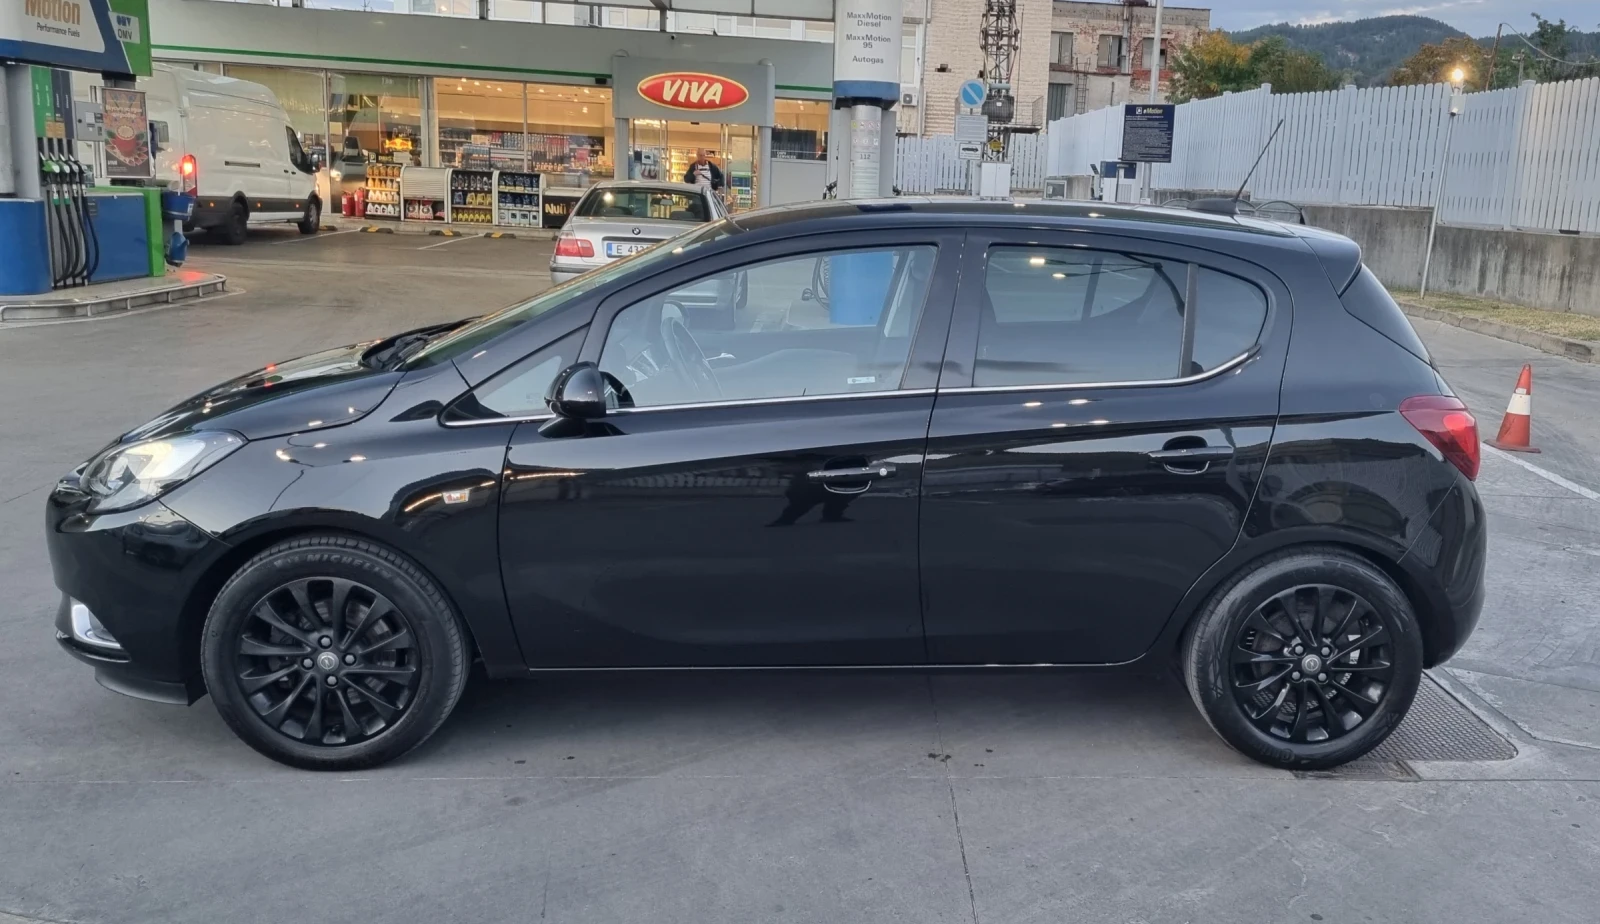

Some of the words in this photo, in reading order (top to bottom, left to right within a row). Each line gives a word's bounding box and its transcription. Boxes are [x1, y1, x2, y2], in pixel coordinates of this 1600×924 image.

[847, 11, 892, 21] MaxxMotion
[857, 19, 881, 27] Diesel
[36, 22, 67, 36] Performance
[67, 28, 81, 38] Fuels
[118, 28, 133, 40] OMV
[846, 33, 891, 43] MaxxMotion
[863, 41, 873, 49] 95
[852, 55, 884, 64] Autogas
[663, 78, 723, 105] VIVA
[616, 244, 623, 254] E
